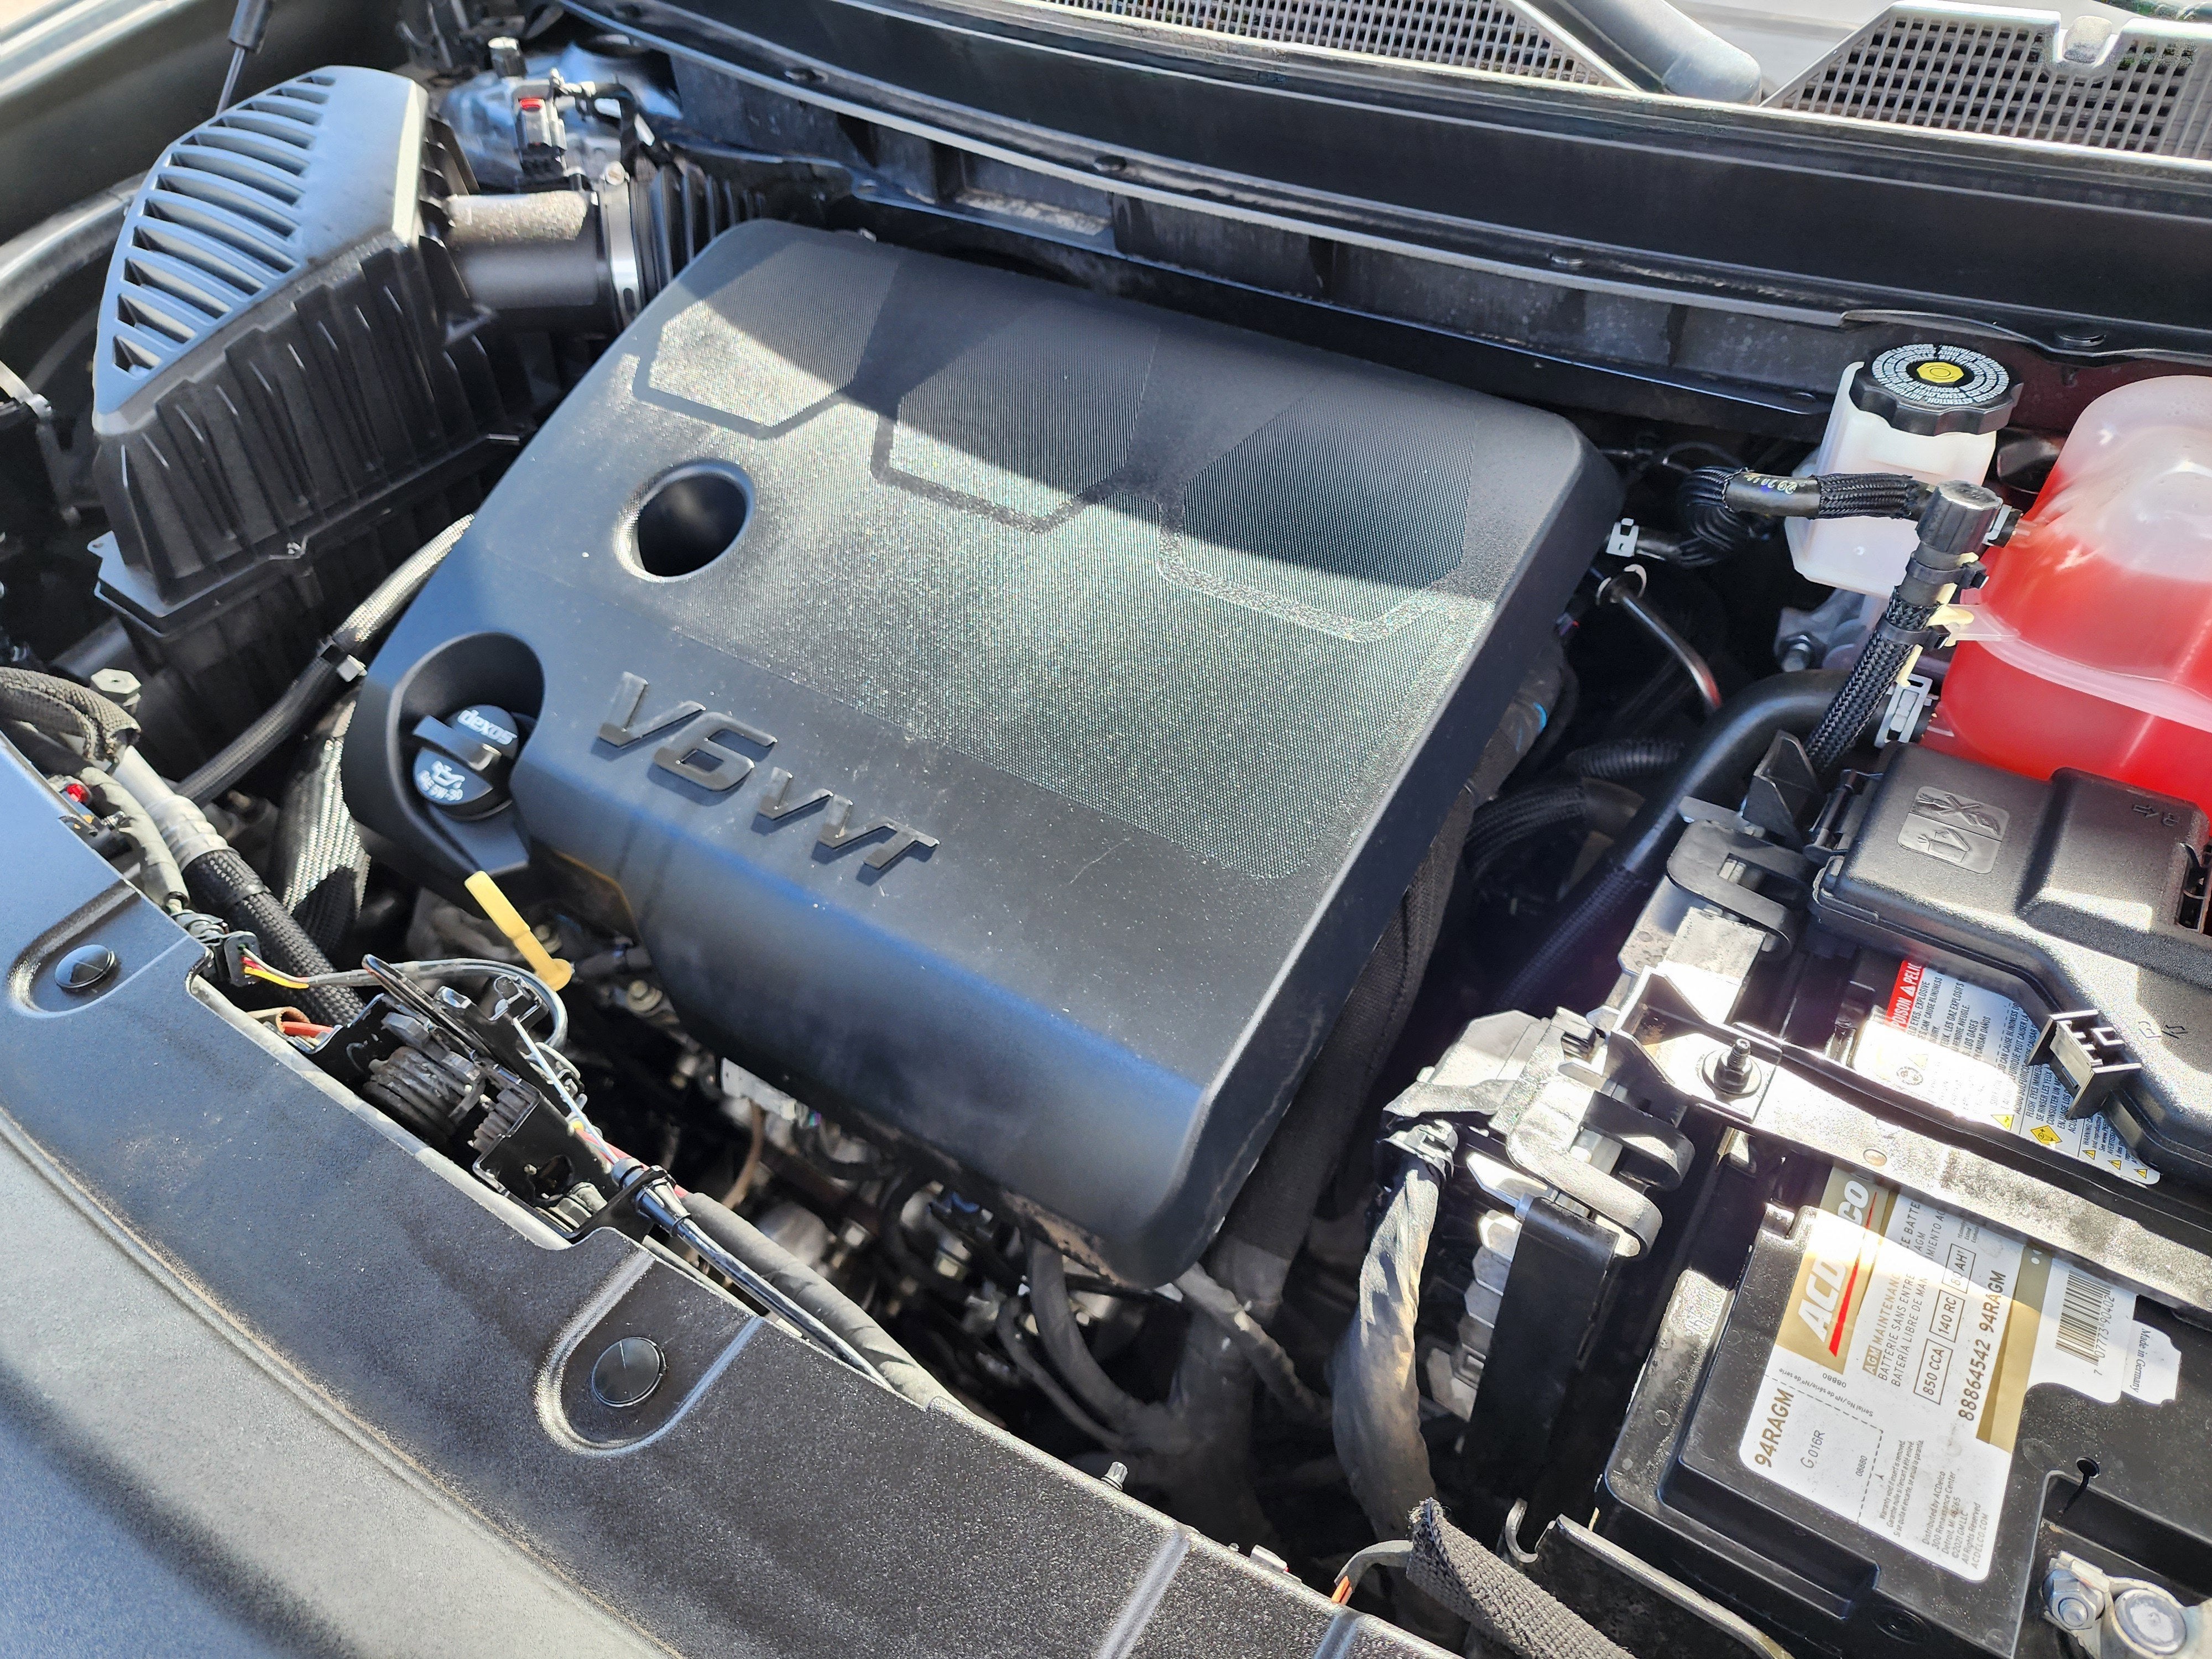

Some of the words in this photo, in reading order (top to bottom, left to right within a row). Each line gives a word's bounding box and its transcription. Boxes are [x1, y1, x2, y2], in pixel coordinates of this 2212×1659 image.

[457, 709, 518, 745] dexos
[597, 670, 778, 791] V6
[757, 766, 941, 870] VVT
[1914, 980, 1930, 1009] EXPLOSIVE
[1928, 977, 1943, 1003] BLINDNESS
[1924, 1002, 1935, 1019] CAUSE
[1943, 1021, 1954, 1032] LES
[1949, 982, 1964, 1010] EXPLOSIFS
[1921, 1020, 1931, 1031] CAN
[1966, 1019, 1979, 1038] GASES
[1980, 1016, 1991, 1034] DAÑOS
[2006, 1010, 2018, 1037] BLINDNESS
[2017, 1021, 2028, 1040] CAUSER
[1952, 1026, 1964, 1047] RENDRE
[1963, 1037, 1974, 1050] LOS
[1975, 1033, 1987, 1054] CAUSAR
[2002, 1036, 2013, 1053] CAUSE
[2014, 1039, 2024, 1053] PEUT
[2027, 1029, 2038, 1048] CAUSAR
[2000, 1052, 2009, 1064] CAN
[2043, 1071, 2053, 1084] YEUX
[2030, 1086, 2039, 1099] EYES
[2041, 1084, 2050, 1095] LES
[2052, 1086, 2061, 1095] UN
[2062, 1094, 2071, 1105] LOS
[2026, 1100, 2037, 1118] FLUSH
[2037, 1094, 2048, 1114] RINSER
[2046, 1095, 2059, 1125] CONSULTER
[2036, 1113, 2044, 1121] SE
[2057, 1104, 2069, 1129] ENJUAGE
[1863, 1346, 1881, 1374] AGM
[1903, 1201, 1921, 1235] BATTE
[1950, 1271, 1963, 1286] 80
[1877, 1333, 1898, 1381] BATTERIE
[1891, 1306, 1906, 1331] SANS
[1912, 1232, 1926, 1252] AGM
[1943, 1297, 1957, 1313] RC
[2100, 1295, 2115, 1324] 90402
[1938, 1314, 1952, 1334] 140
[1891, 1345, 1910, 1387] BATERÍA
[1902, 1313, 1918, 1343] LIBRE
[1911, 1298, 1922, 1312] DE
[1958, 1339, 1991, 1421] 88864542
[1979, 1270, 2006, 1333] 94RAGM
[2094, 1327, 2109, 1358] 07773
[2139, 1328, 2151, 1349] Made
[1929, 1349, 1944, 1370] CCA
[2137, 1349, 2147, 1358] in
[1779, 1368, 1793, 1378] serie
[1821, 1372, 1847, 1388] 08880
[2130, 1359, 2146, 1393] Germany
[1923, 1373, 1937, 1395] 850
[1856, 1405, 1874, 1417] Serial
[1755, 1387, 1794, 1468] 94RAGM
[1800, 1457, 1814, 1468] G
[1808, 1430, 1825, 1458] 016R
[1855, 1455, 1867, 1477] 08880
[1879, 1496, 1892, 1520] Warranty
[1889, 1466, 1899, 1482] insert
[1895, 1440, 1906, 1462] removed.
[1933, 1471, 1946, 1499] ACDelco
[1945, 1471, 1955, 1494] Center
[1886, 1506, 1897, 1528] Garantie
[1893, 1493, 1901, 1506] nulle
[1902, 1457, 1910, 1466] été
[1902, 1486, 1913, 1506] encarte,
[1931, 1499, 1940, 1508] by
[1950, 1496, 1961, 1519] 48265
[1936, 1494, 1951, 1535] Renaissance
[1948, 1519, 1955, 1528] MI
[1959, 1510, 1968, 1525] LLC
[1968, 1501, 1981, 1533] Reserved
[1921, 1506, 1937, 1545] Distributed
[1957, 1524, 1966, 1536] GM
[1932, 1534, 1942, 1550] 300
[1951, 1535, 1963, 1558] ©2021
[1963, 1533, 1975, 1554] Rights
[1971, 1512, 1989, 1569] ACDELCO.COM
[1961, 1553, 1969, 1564] All
